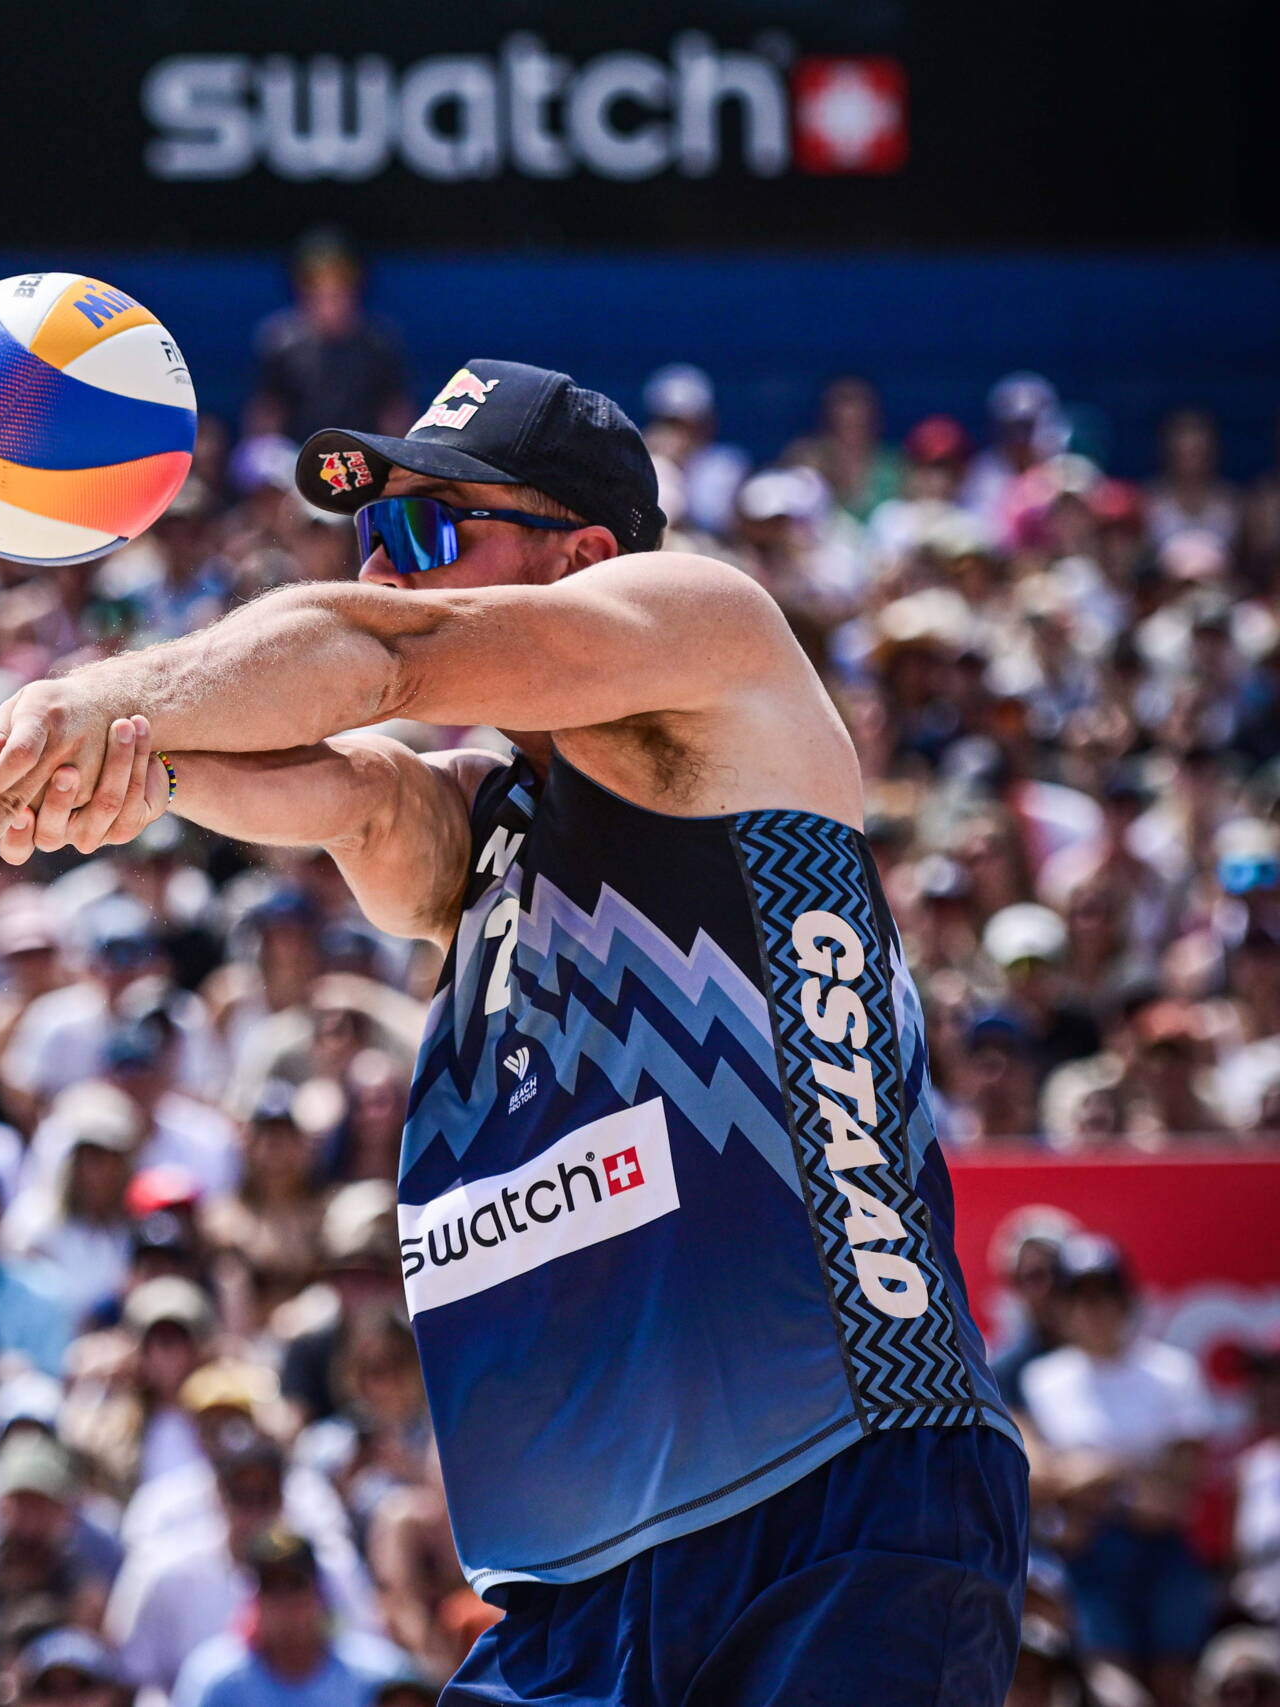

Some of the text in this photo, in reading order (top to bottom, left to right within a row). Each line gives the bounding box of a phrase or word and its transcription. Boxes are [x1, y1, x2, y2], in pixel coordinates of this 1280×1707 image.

[142, 32, 788, 180] swatch
[509, 1076, 537, 1106] BEACH
[791, 910, 929, 1319] GSTAAD
[401, 1161, 602, 1280] swatch
